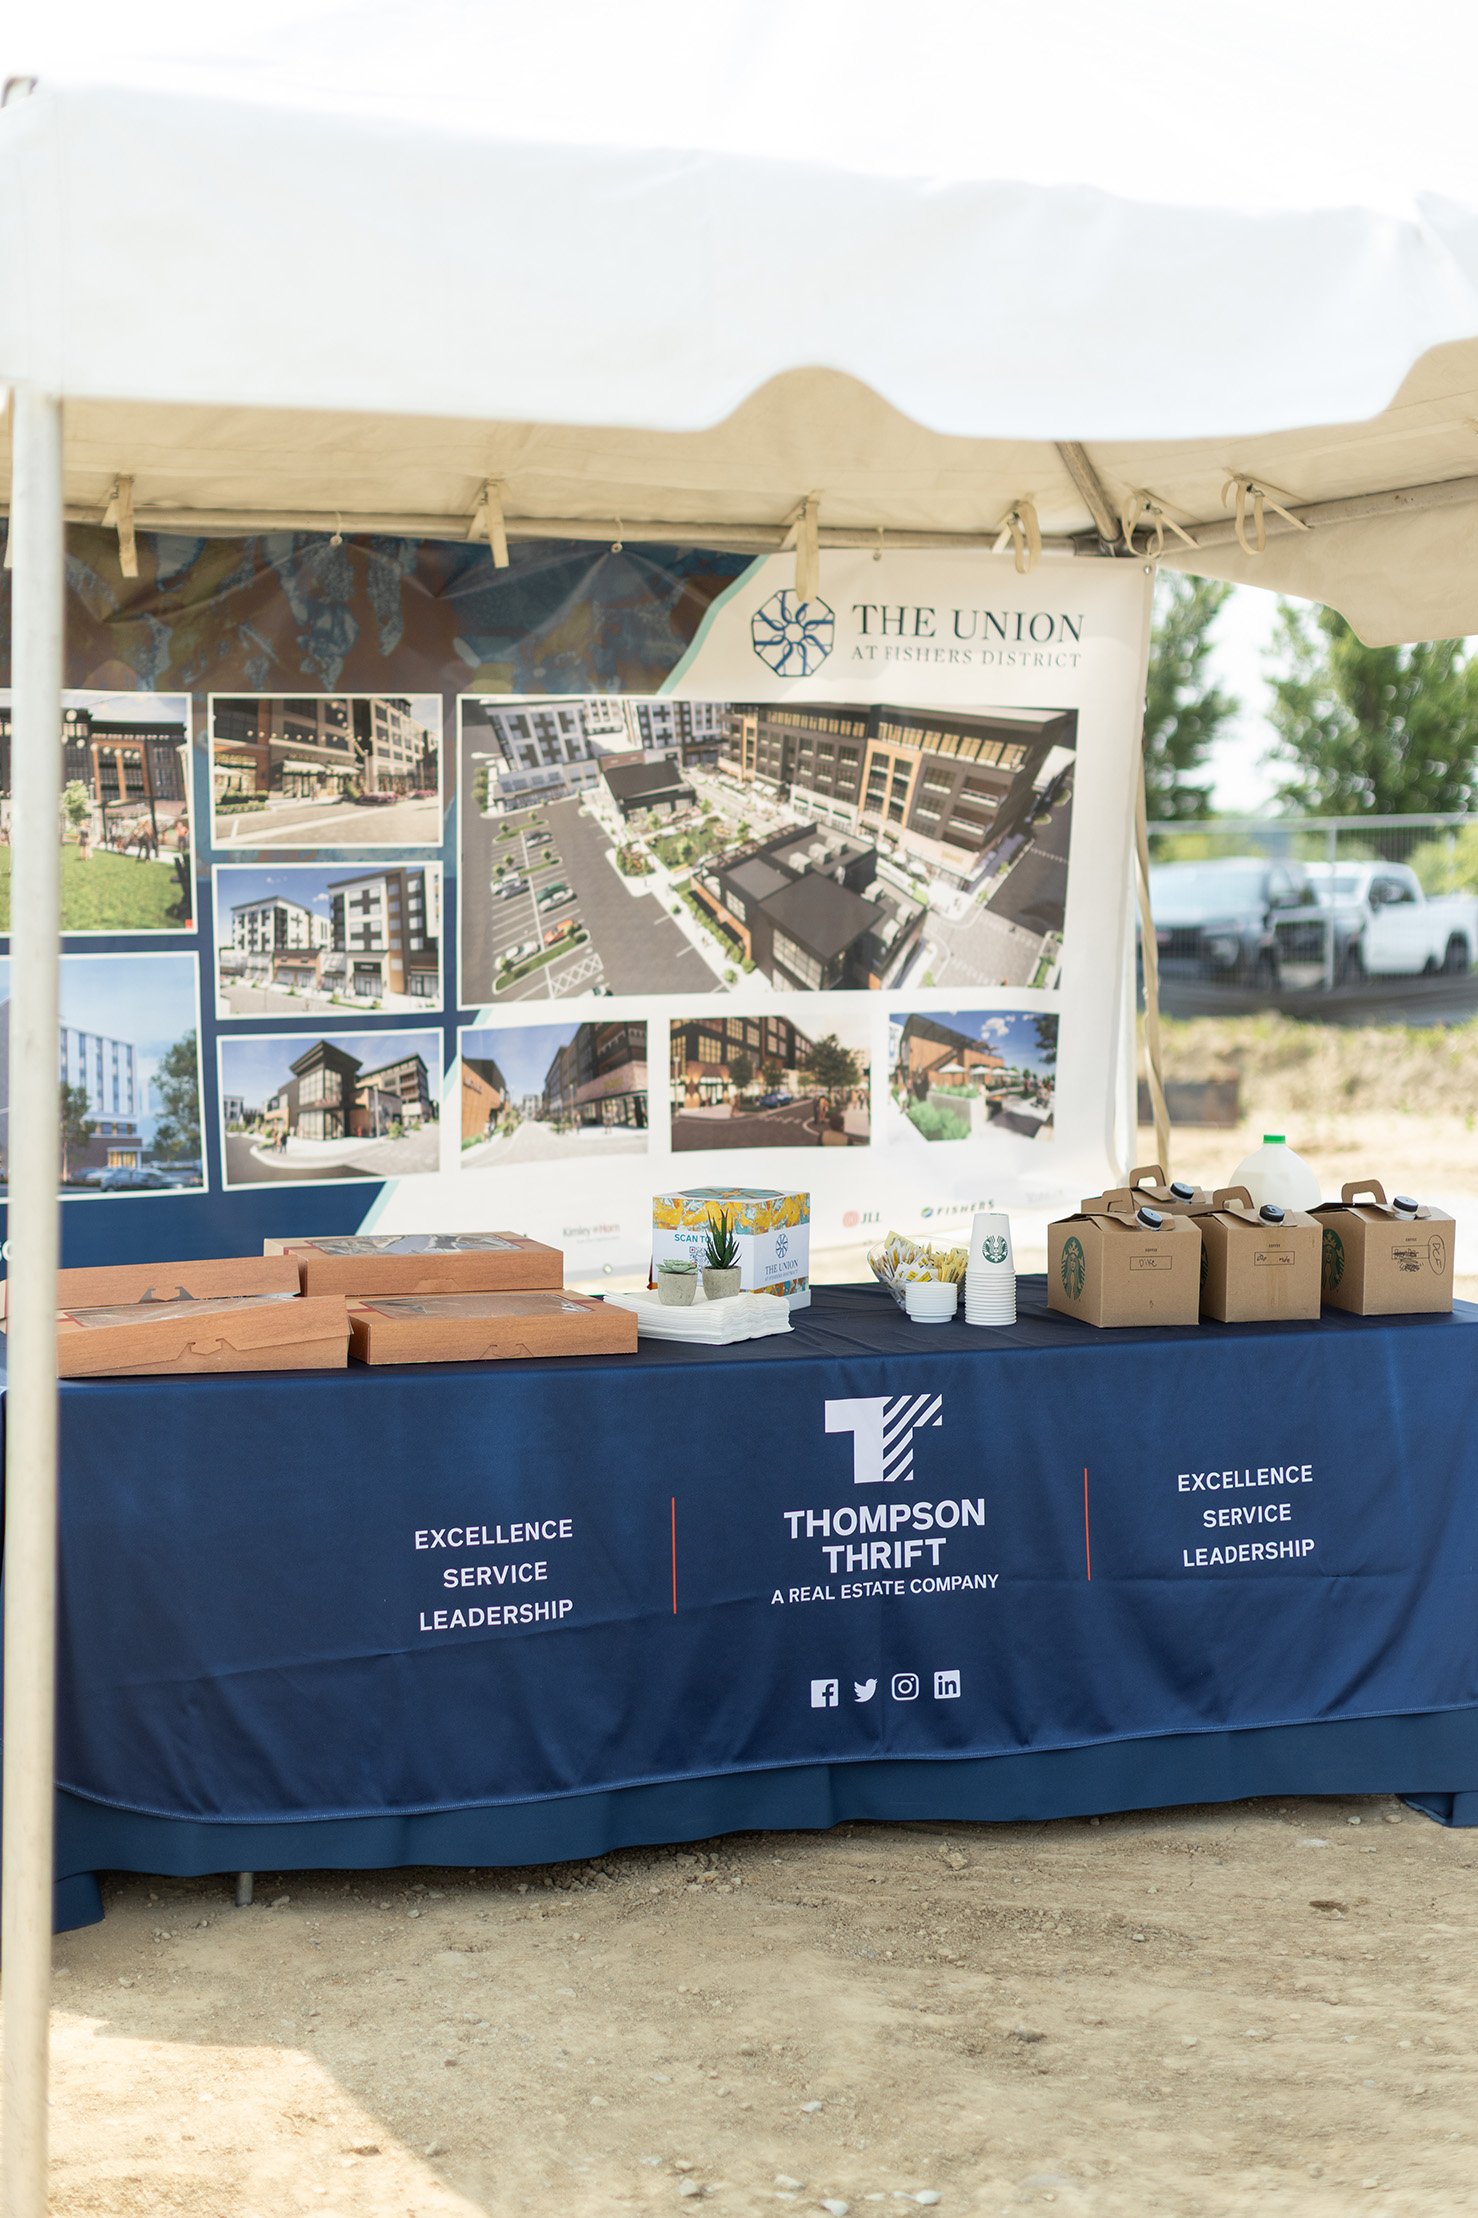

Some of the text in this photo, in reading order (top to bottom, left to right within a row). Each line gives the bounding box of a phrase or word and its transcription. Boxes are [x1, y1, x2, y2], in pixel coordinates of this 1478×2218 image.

[852, 604, 1084, 643] THE UNION
[852, 644, 1082, 668] AT FISHERS DISTRICT
[937, 1199, 994, 1216] FISHERS
[674, 1233, 698, 1243] SCAN
[765, 1263, 778, 1275] THE
[779, 1258, 799, 1272] UNION
[1178, 1464, 1314, 1492] EXCELLENCE
[783, 1498, 985, 1539] THOMPSON
[1203, 1503, 1292, 1528] SERVICE
[415, 1519, 573, 1550] EXCELLENCE
[822, 1537, 947, 1573] THRIFT
[1183, 1539, 1315, 1567] LEADERSHIP
[443, 1561, 548, 1588] SERVICE
[771, 1574, 999, 1605] A REAL ESTATE COMPANY
[420, 1599, 573, 1631] LEADERSHIP
